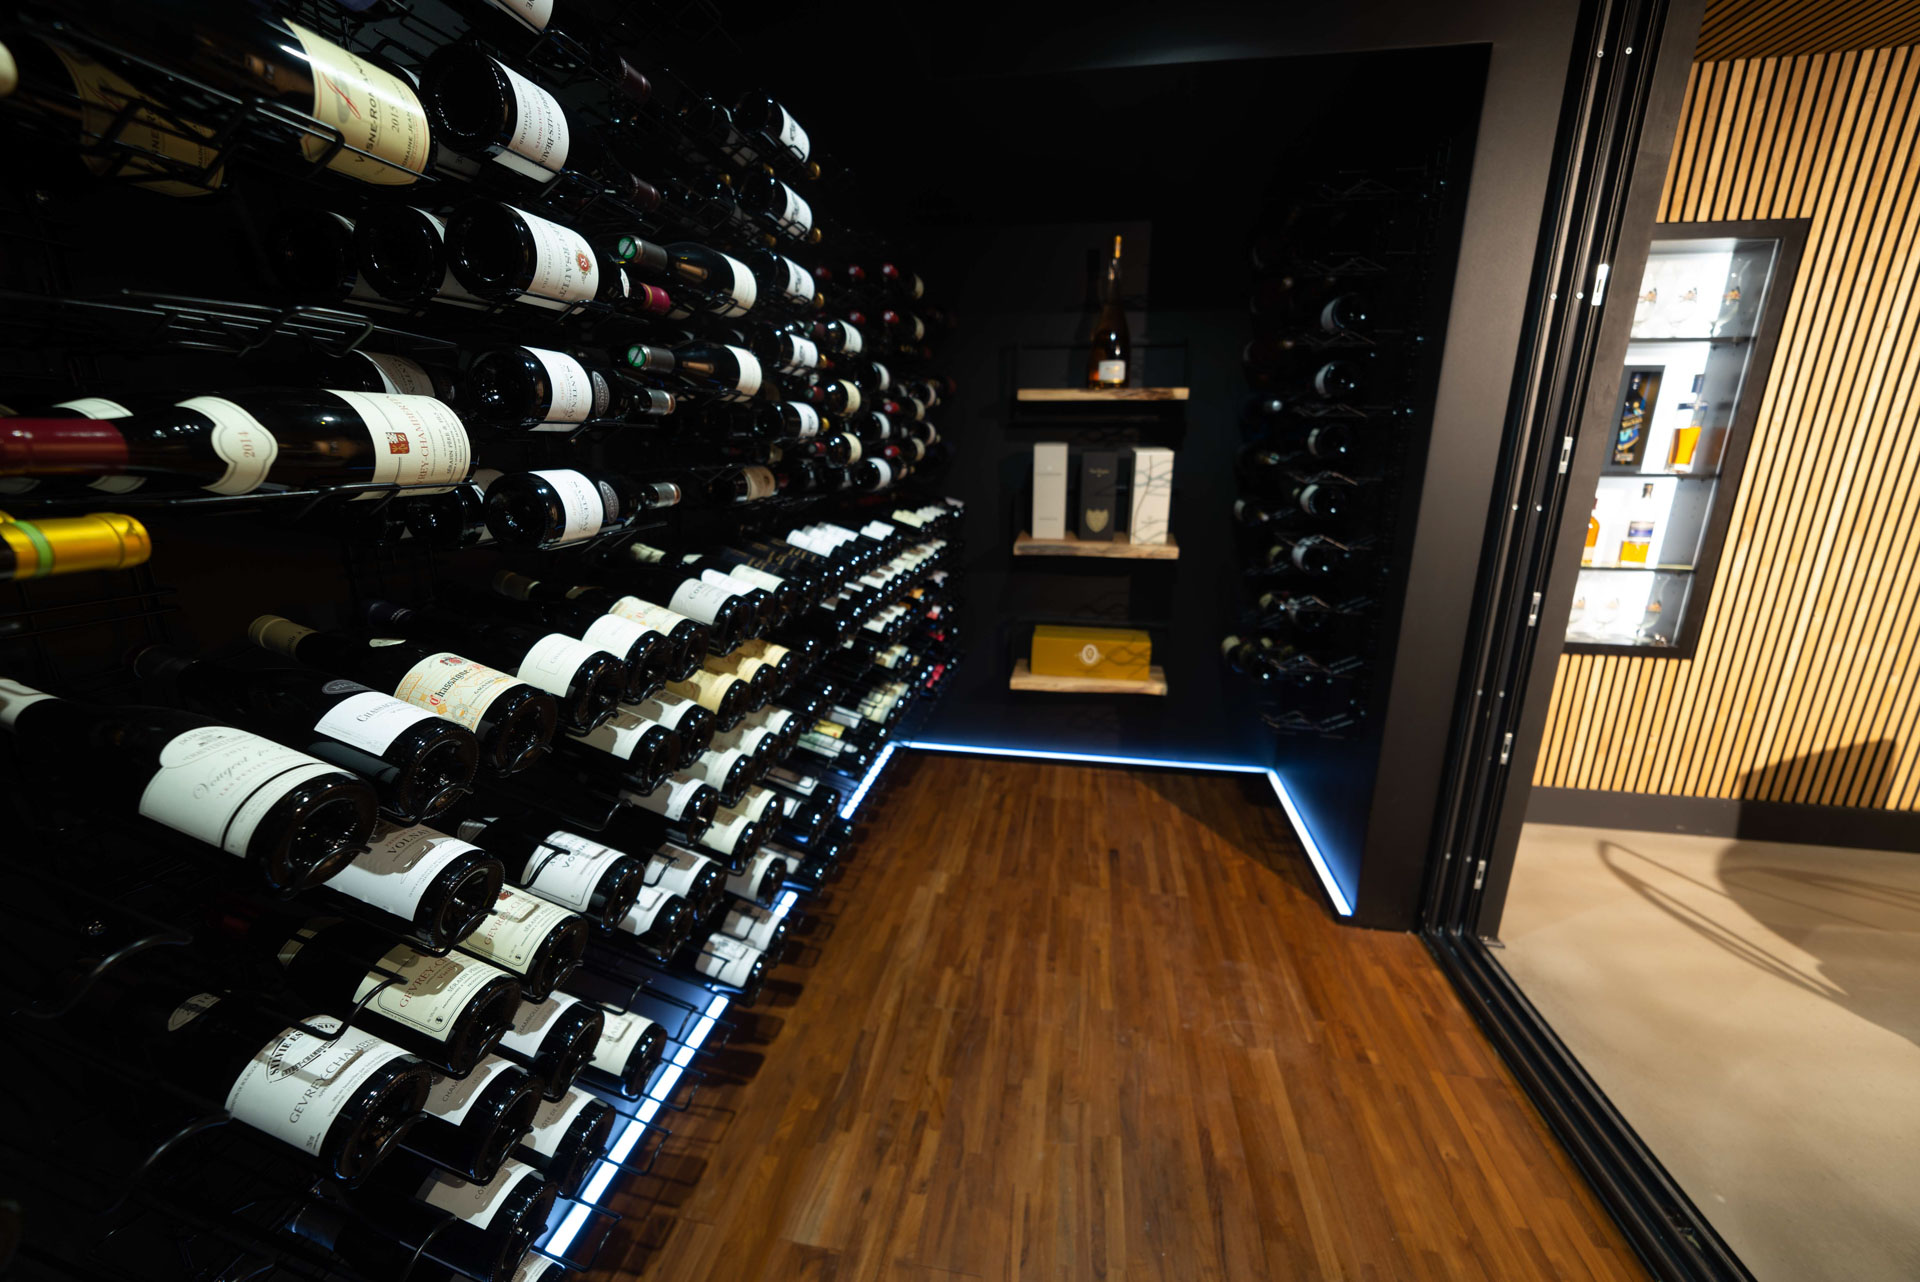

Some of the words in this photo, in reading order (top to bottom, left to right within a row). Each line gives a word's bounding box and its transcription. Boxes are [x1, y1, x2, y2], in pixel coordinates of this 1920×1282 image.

[238, 431, 256, 459] 2014
[385, 394, 430, 485] VREY-CHAMBERTIN
[387, 828, 430, 855] VOLNAY
[269, 1042, 292, 1077] SYLVIE
